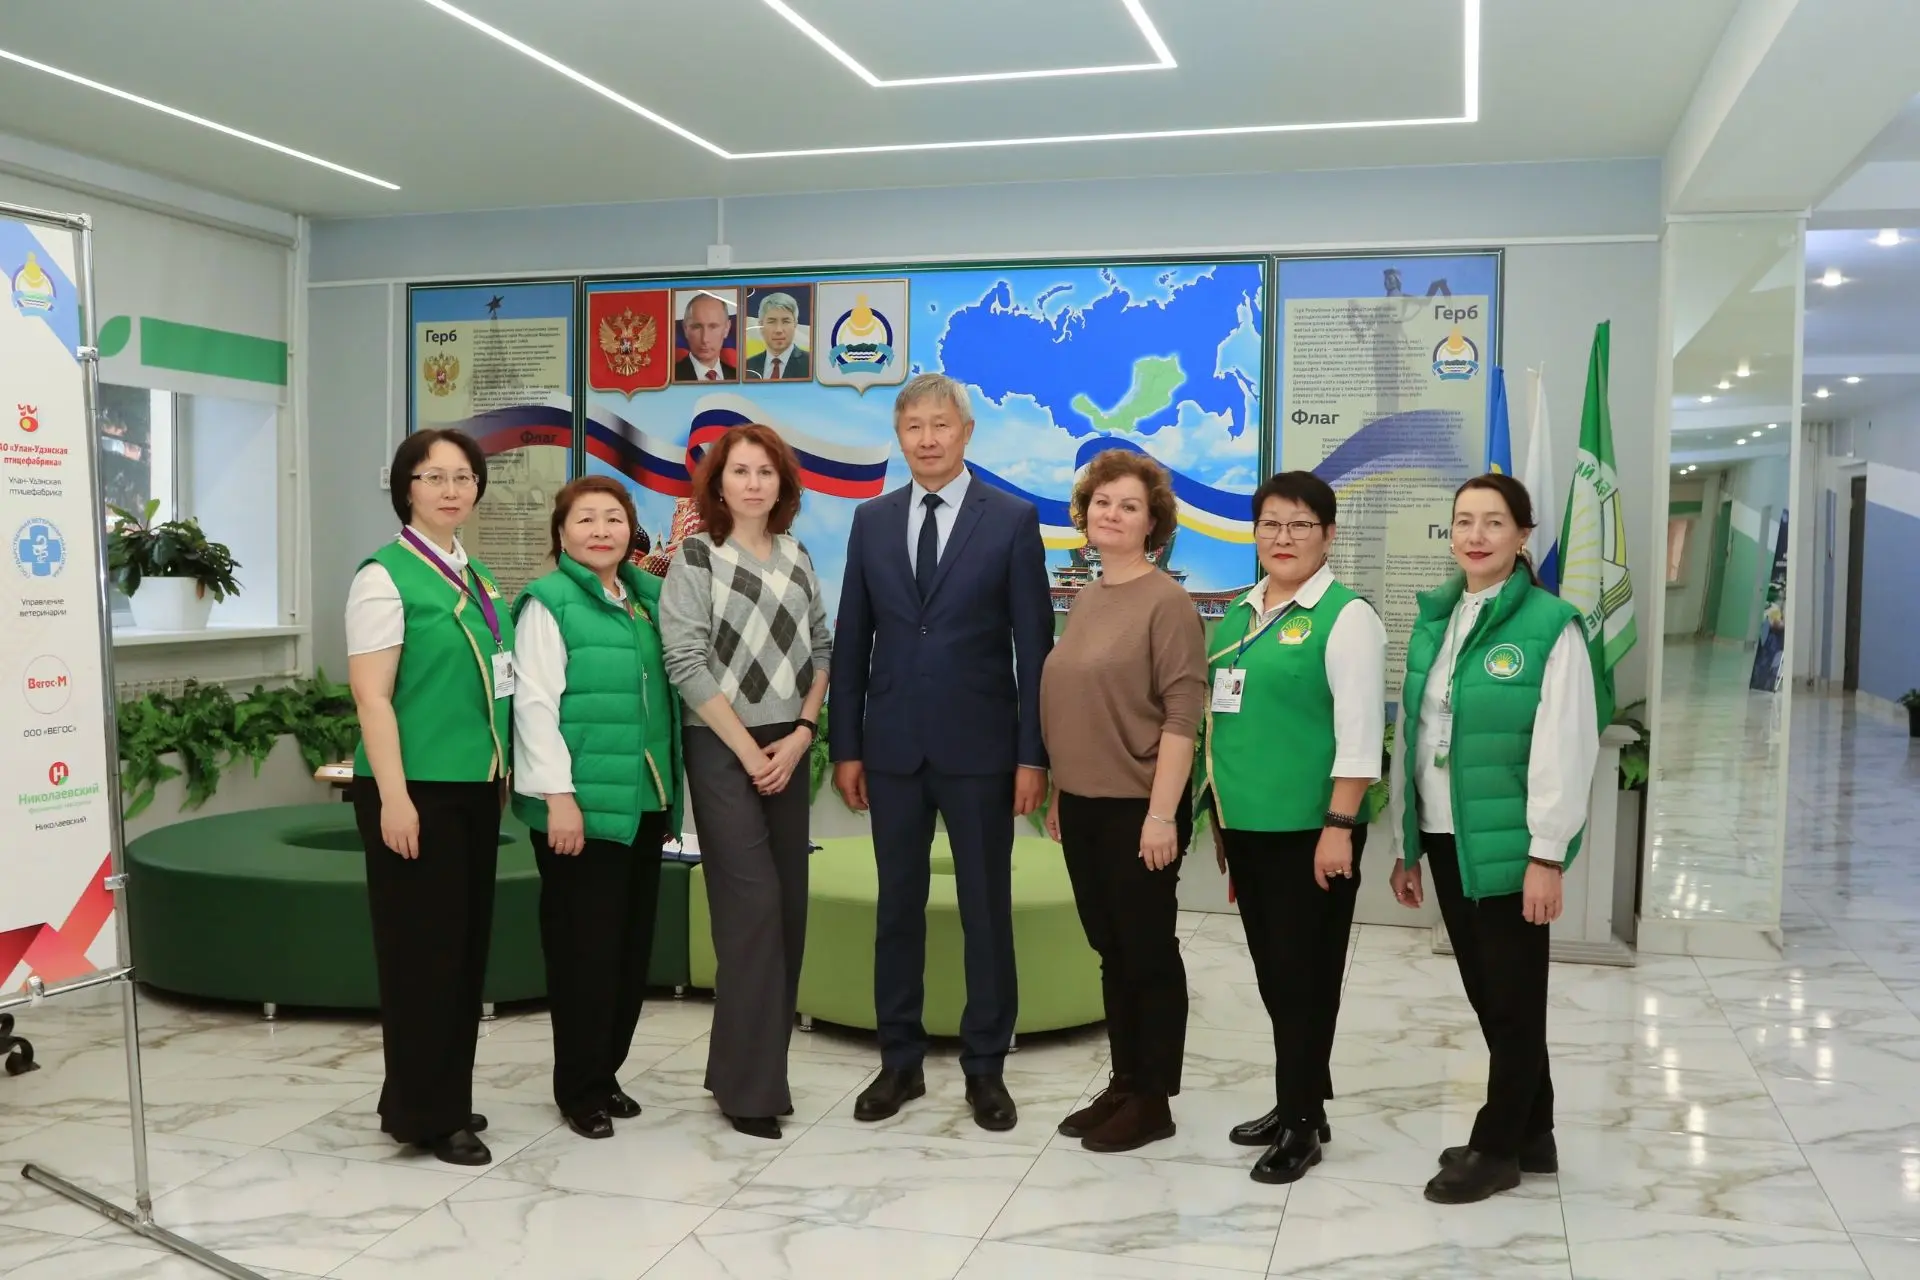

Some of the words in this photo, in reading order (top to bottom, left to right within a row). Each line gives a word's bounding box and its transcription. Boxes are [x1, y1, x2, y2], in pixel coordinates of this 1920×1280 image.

[1434, 305, 1478, 324] Герб
[425, 330, 457, 346] Герб
[1291, 409, 1340, 426] Флаг
[520, 431, 557, 445] Флаг
[8, 476, 62, 486] Улан-Удэнская
[9, 488, 63, 497] птицефабрика
[21, 598, 65, 607] Управление
[19, 609, 67, 618] ветеринарии
[23, 728, 42, 738] ООО
[18, 783, 99, 804] Николаевский
[35, 816, 87, 830] Николаевский
